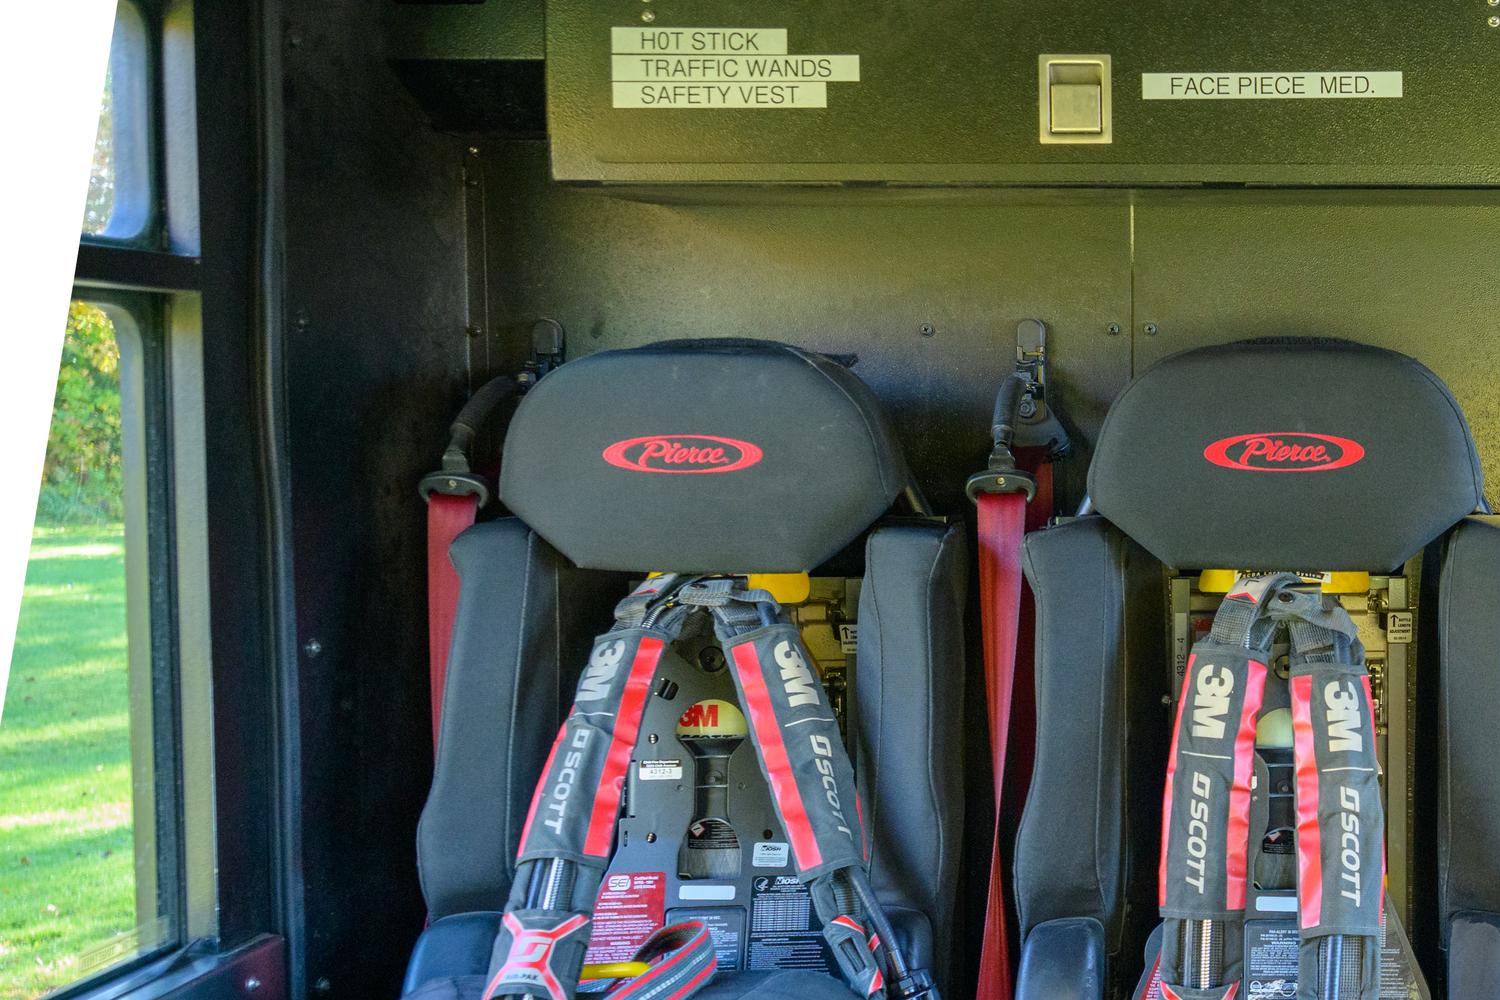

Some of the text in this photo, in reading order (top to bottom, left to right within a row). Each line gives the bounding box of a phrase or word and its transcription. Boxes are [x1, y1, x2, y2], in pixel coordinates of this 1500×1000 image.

[691, 31, 759, 51] STICK
[640, 59, 832, 78] TRAFFIC WANDS
[641, 85, 800, 104] SAFETY VEST
[1170, 76, 1375, 95] FACE PIECE MED.
[638, 440, 725, 467] Pierce
[1239, 438, 1327, 465] Pierce
[773, 640, 821, 708] 3M
[679, 704, 719, 728] 3M
[545, 640, 626, 835] 3M SCOTT
[1186, 664, 1235, 895] 3M SCOTT
[1324, 681, 1364, 908] 3M SCOTT
